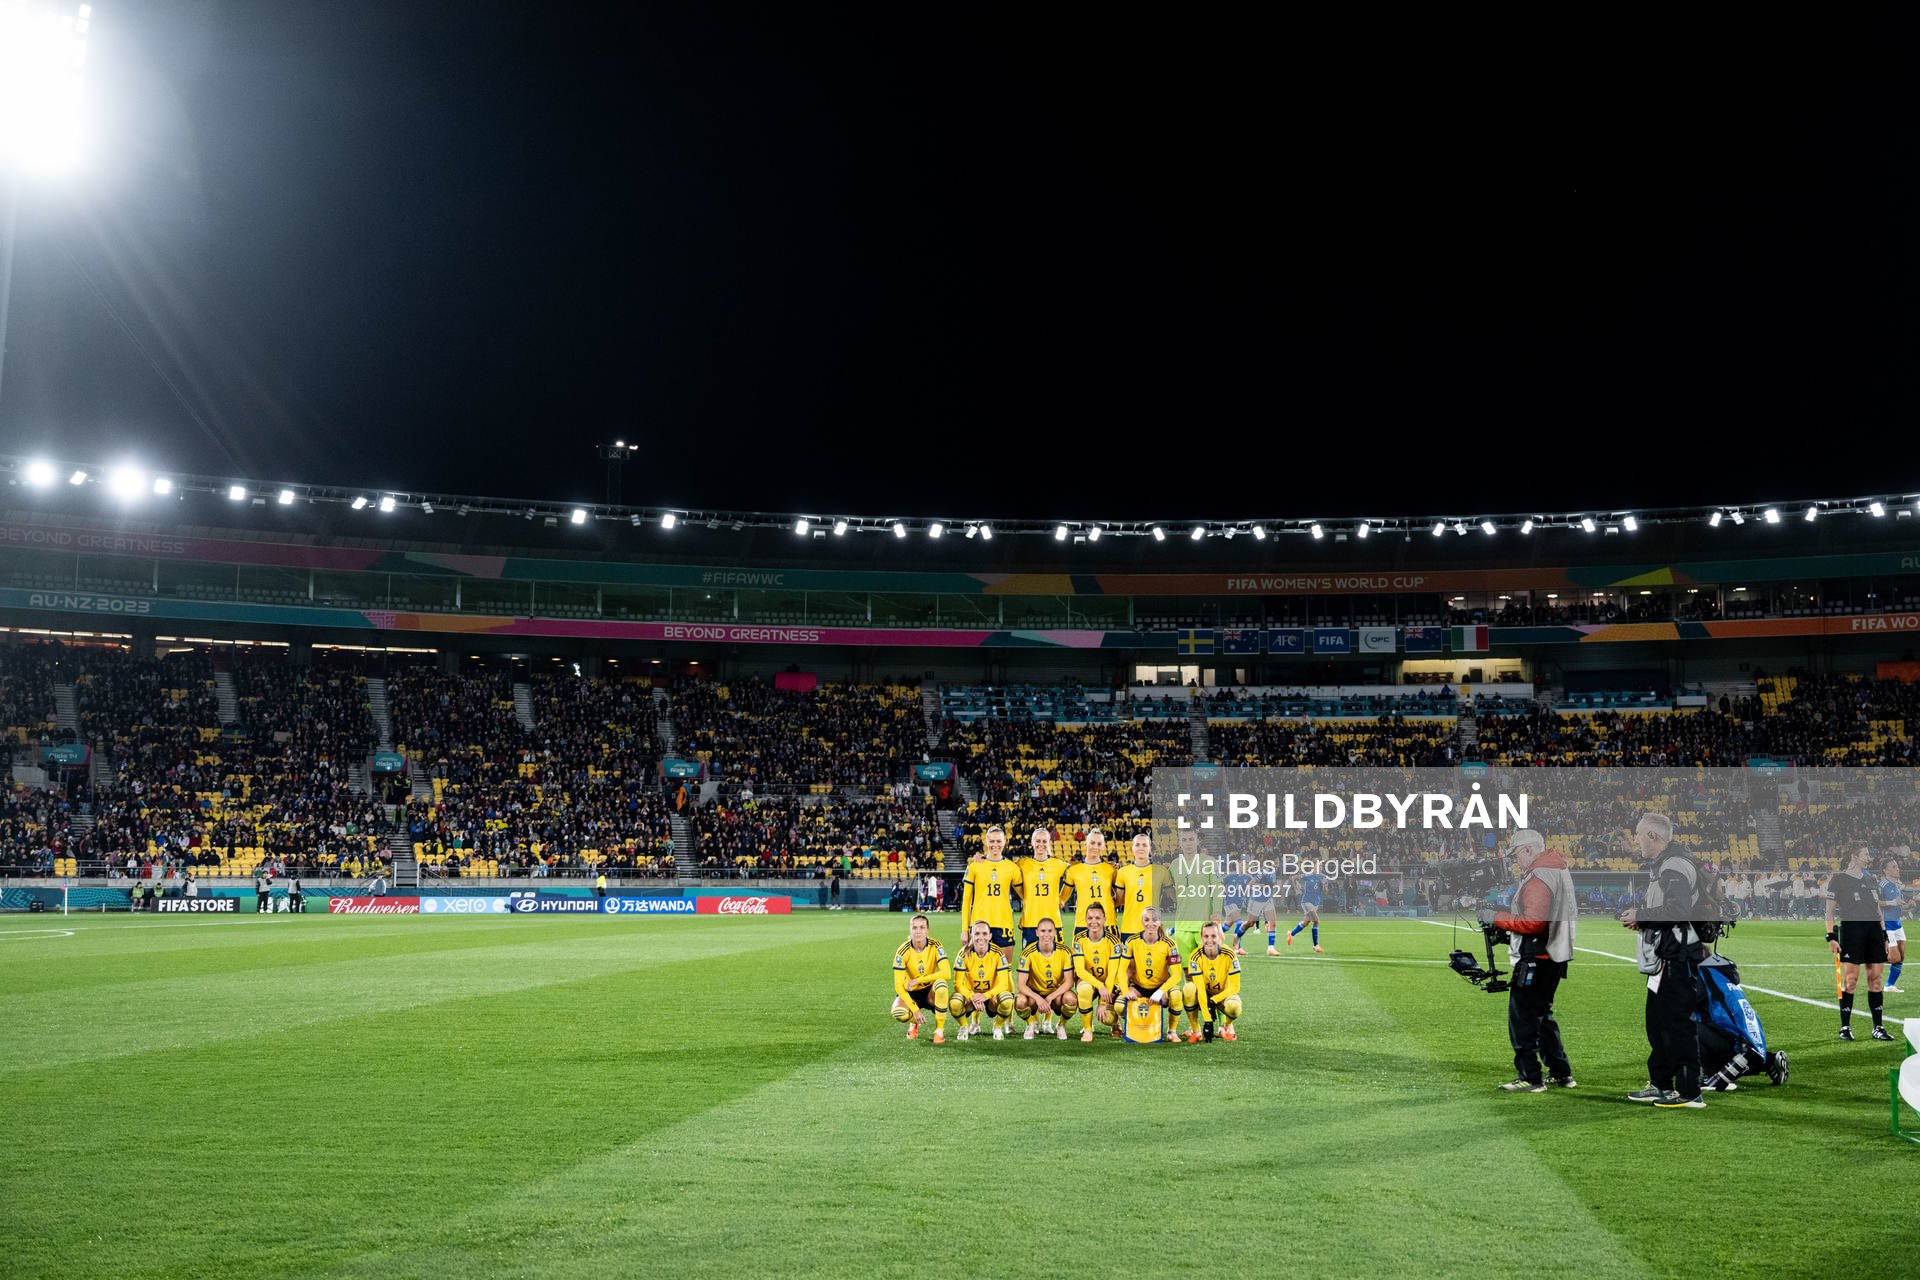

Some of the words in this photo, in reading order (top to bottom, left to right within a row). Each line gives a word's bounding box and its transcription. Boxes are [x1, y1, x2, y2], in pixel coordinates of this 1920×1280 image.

[0, 527, 72, 545] BEYOND
[78, 534, 185, 554] GREATNESS
[702, 571, 784, 586] #FIFAWWC
[1226, 578, 1258, 591] FIFA
[1260, 578, 1332, 590] WOMEN'S
[1335, 577, 1389, 589] WORLD
[1393, 576, 1424, 589] CUP
[1852, 617, 1888, 631] FIFA
[663, 625, 727, 640] BEYOND
[730, 627, 819, 642] GREATNESS
[1272, 634, 1297, 647] AFC
[1319, 635, 1345, 646] FIFA
[986, 883, 1001, 897] 18
[1035, 883, 1050, 897] 13
[1090, 885, 1103, 899] 11
[1136, 889, 1144, 903] 6
[158, 899, 188, 912] FIFA
[190, 899, 235, 912] STORE
[329, 898, 420, 914] Budweiser
[444, 898, 488, 912] xero
[540, 900, 598, 910] HYUNDAI
[649, 900, 695, 911] WANDA
[717, 897, 768, 914] Coca-Cola
[1091, 966, 1105, 978] 19
[1145, 968, 1154, 979] 9
[973, 979, 991, 991] 23
[1206, 982, 1221, 992] 14
